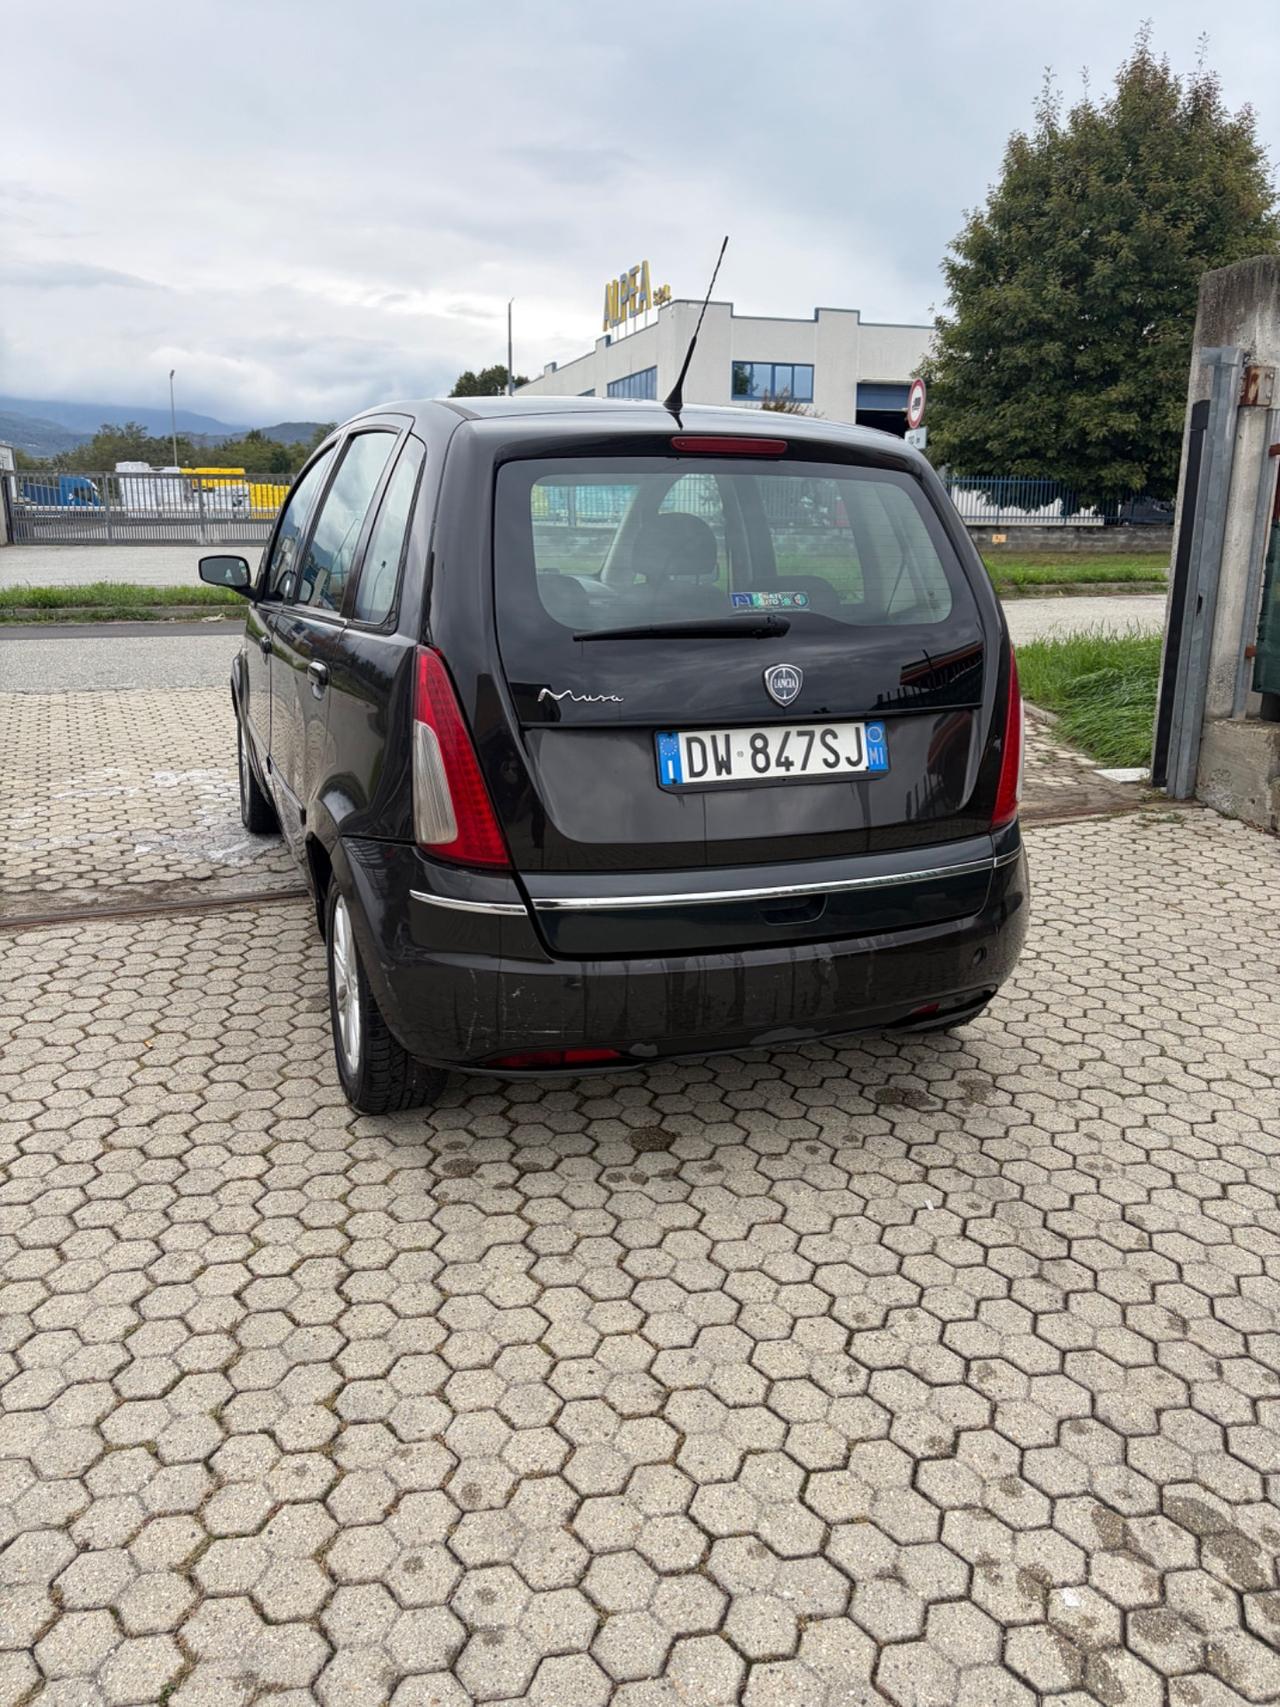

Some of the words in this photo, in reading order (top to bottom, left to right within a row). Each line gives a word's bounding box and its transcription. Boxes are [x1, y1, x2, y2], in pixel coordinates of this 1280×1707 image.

[603, 260, 652, 332] ALPEA
[538, 688, 624, 702] Musa
[773, 678, 797, 689] LANCIA
[685, 733, 733, 778] DW
[749, 726, 864, 774] 847SJ
[869, 747, 884, 766] MI
